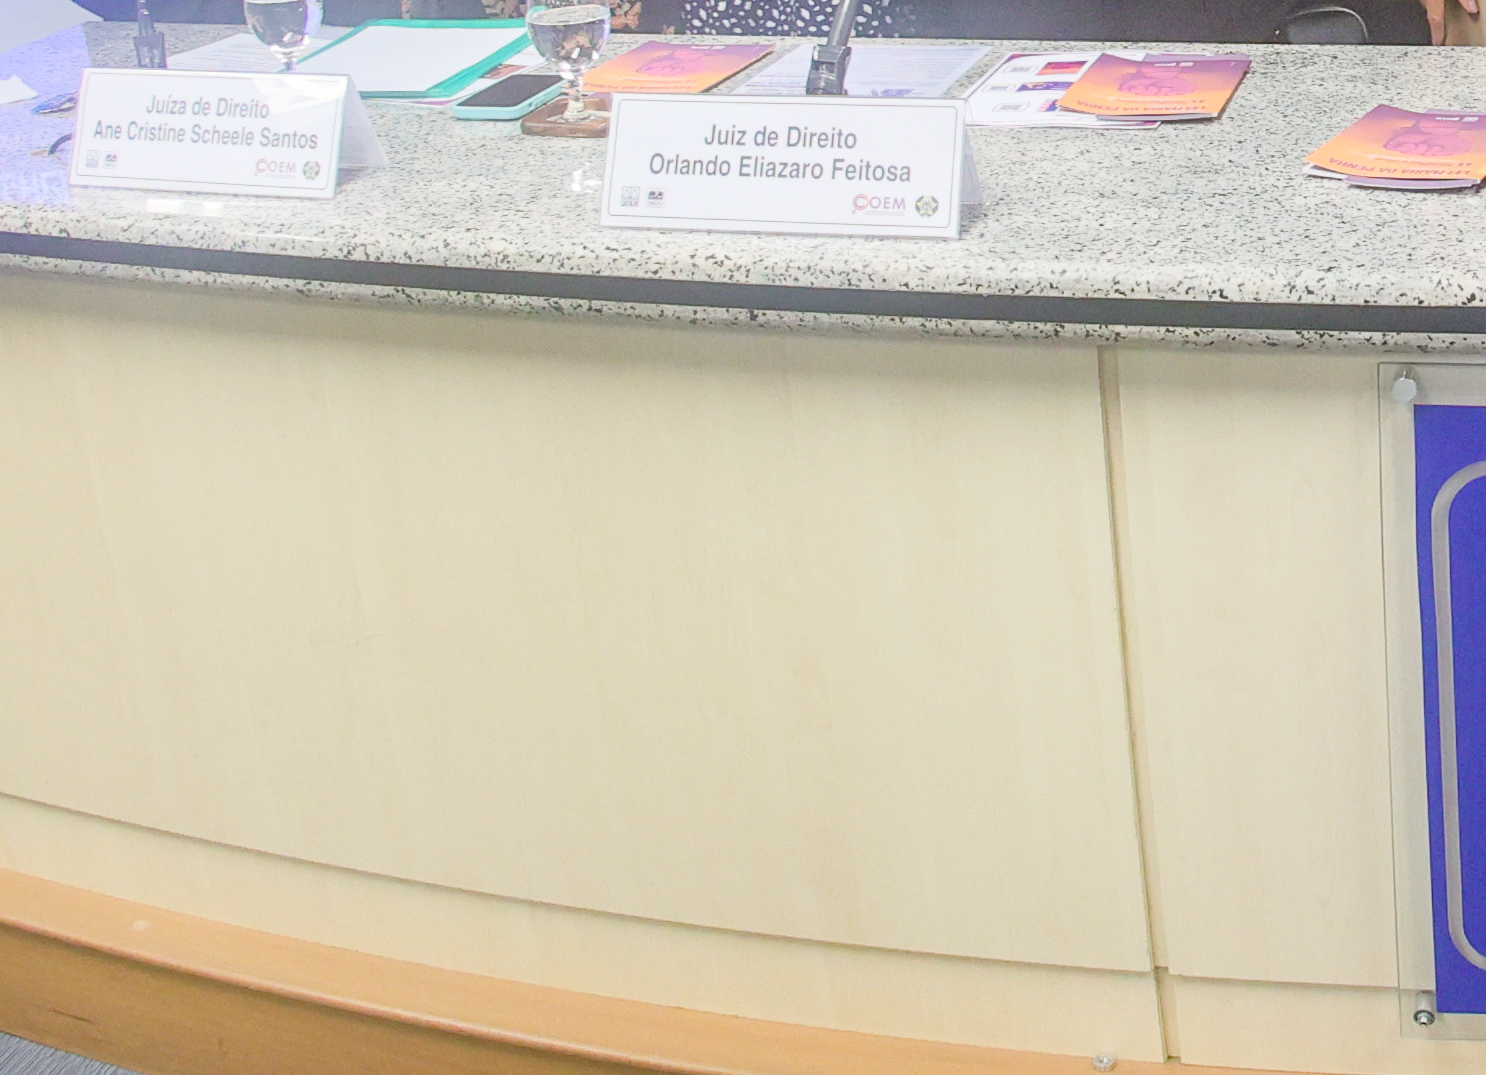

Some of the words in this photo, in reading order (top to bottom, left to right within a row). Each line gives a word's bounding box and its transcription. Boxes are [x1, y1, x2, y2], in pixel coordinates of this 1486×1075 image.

[145, 93, 187, 116] Juíza
[192, 98, 210, 117] de
[216, 97, 270, 120] Direito
[93, 120, 122, 140] Ane
[127, 121, 185, 144] Cristine
[190, 123, 255, 146] Scheele
[259, 126, 318, 150] Santos
[704, 123, 747, 146] Juiz
[753, 126, 779, 148] de
[786, 125, 857, 150] Direito
[649, 152, 731, 177] Orlando
[738, 154, 824, 180] Eliazaro
[831, 157, 911, 183] Feitosa
[851, 193, 907, 215] COEM
